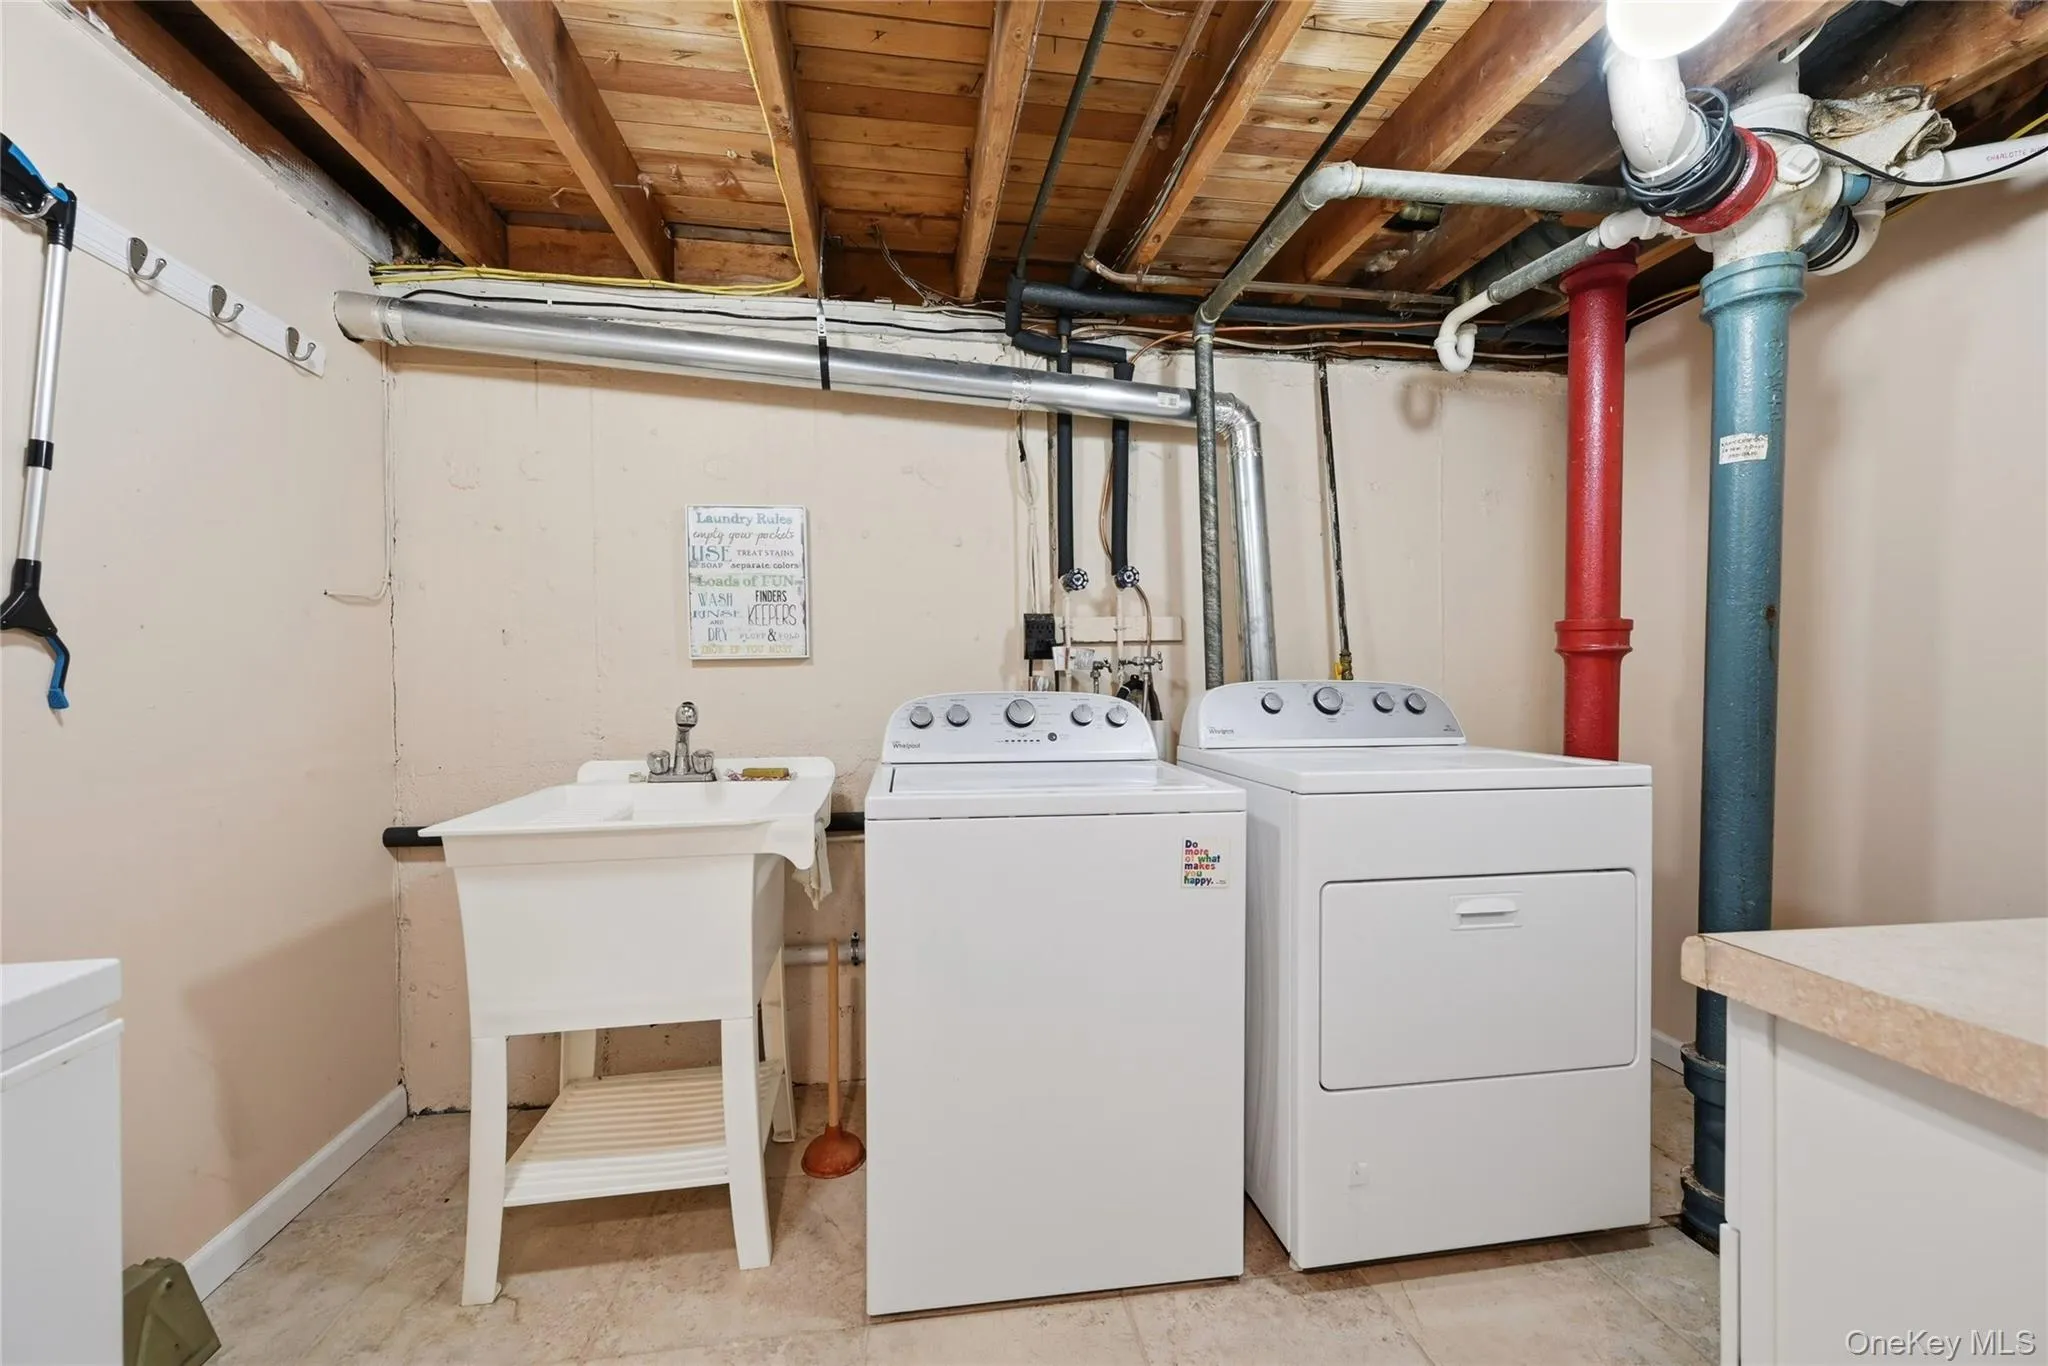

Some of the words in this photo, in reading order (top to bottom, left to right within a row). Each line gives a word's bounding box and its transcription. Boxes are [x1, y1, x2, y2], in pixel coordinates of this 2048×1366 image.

[696, 512, 752, 526] Laundry
[756, 512, 793, 524] Rules
[693, 528, 724, 544] empty
[728, 531, 753, 544] your
[755, 527, 795, 545] pockets
[691, 545, 732, 561] USE
[730, 562, 770, 570] separate
[696, 575, 740, 587] Loads
[742, 575, 758, 587] of
[762, 575, 794, 587] FUN
[698, 592, 733, 607] WASH
[755, 590, 788, 602] FINDERS
[747, 604, 797, 626] KEEPERS
[707, 627, 728, 641] DRY
[767, 628, 777, 642] &
[1185, 840, 1198, 848] Do
[1197, 854, 1220, 863] what
[1184, 876, 1214, 886] happy.
